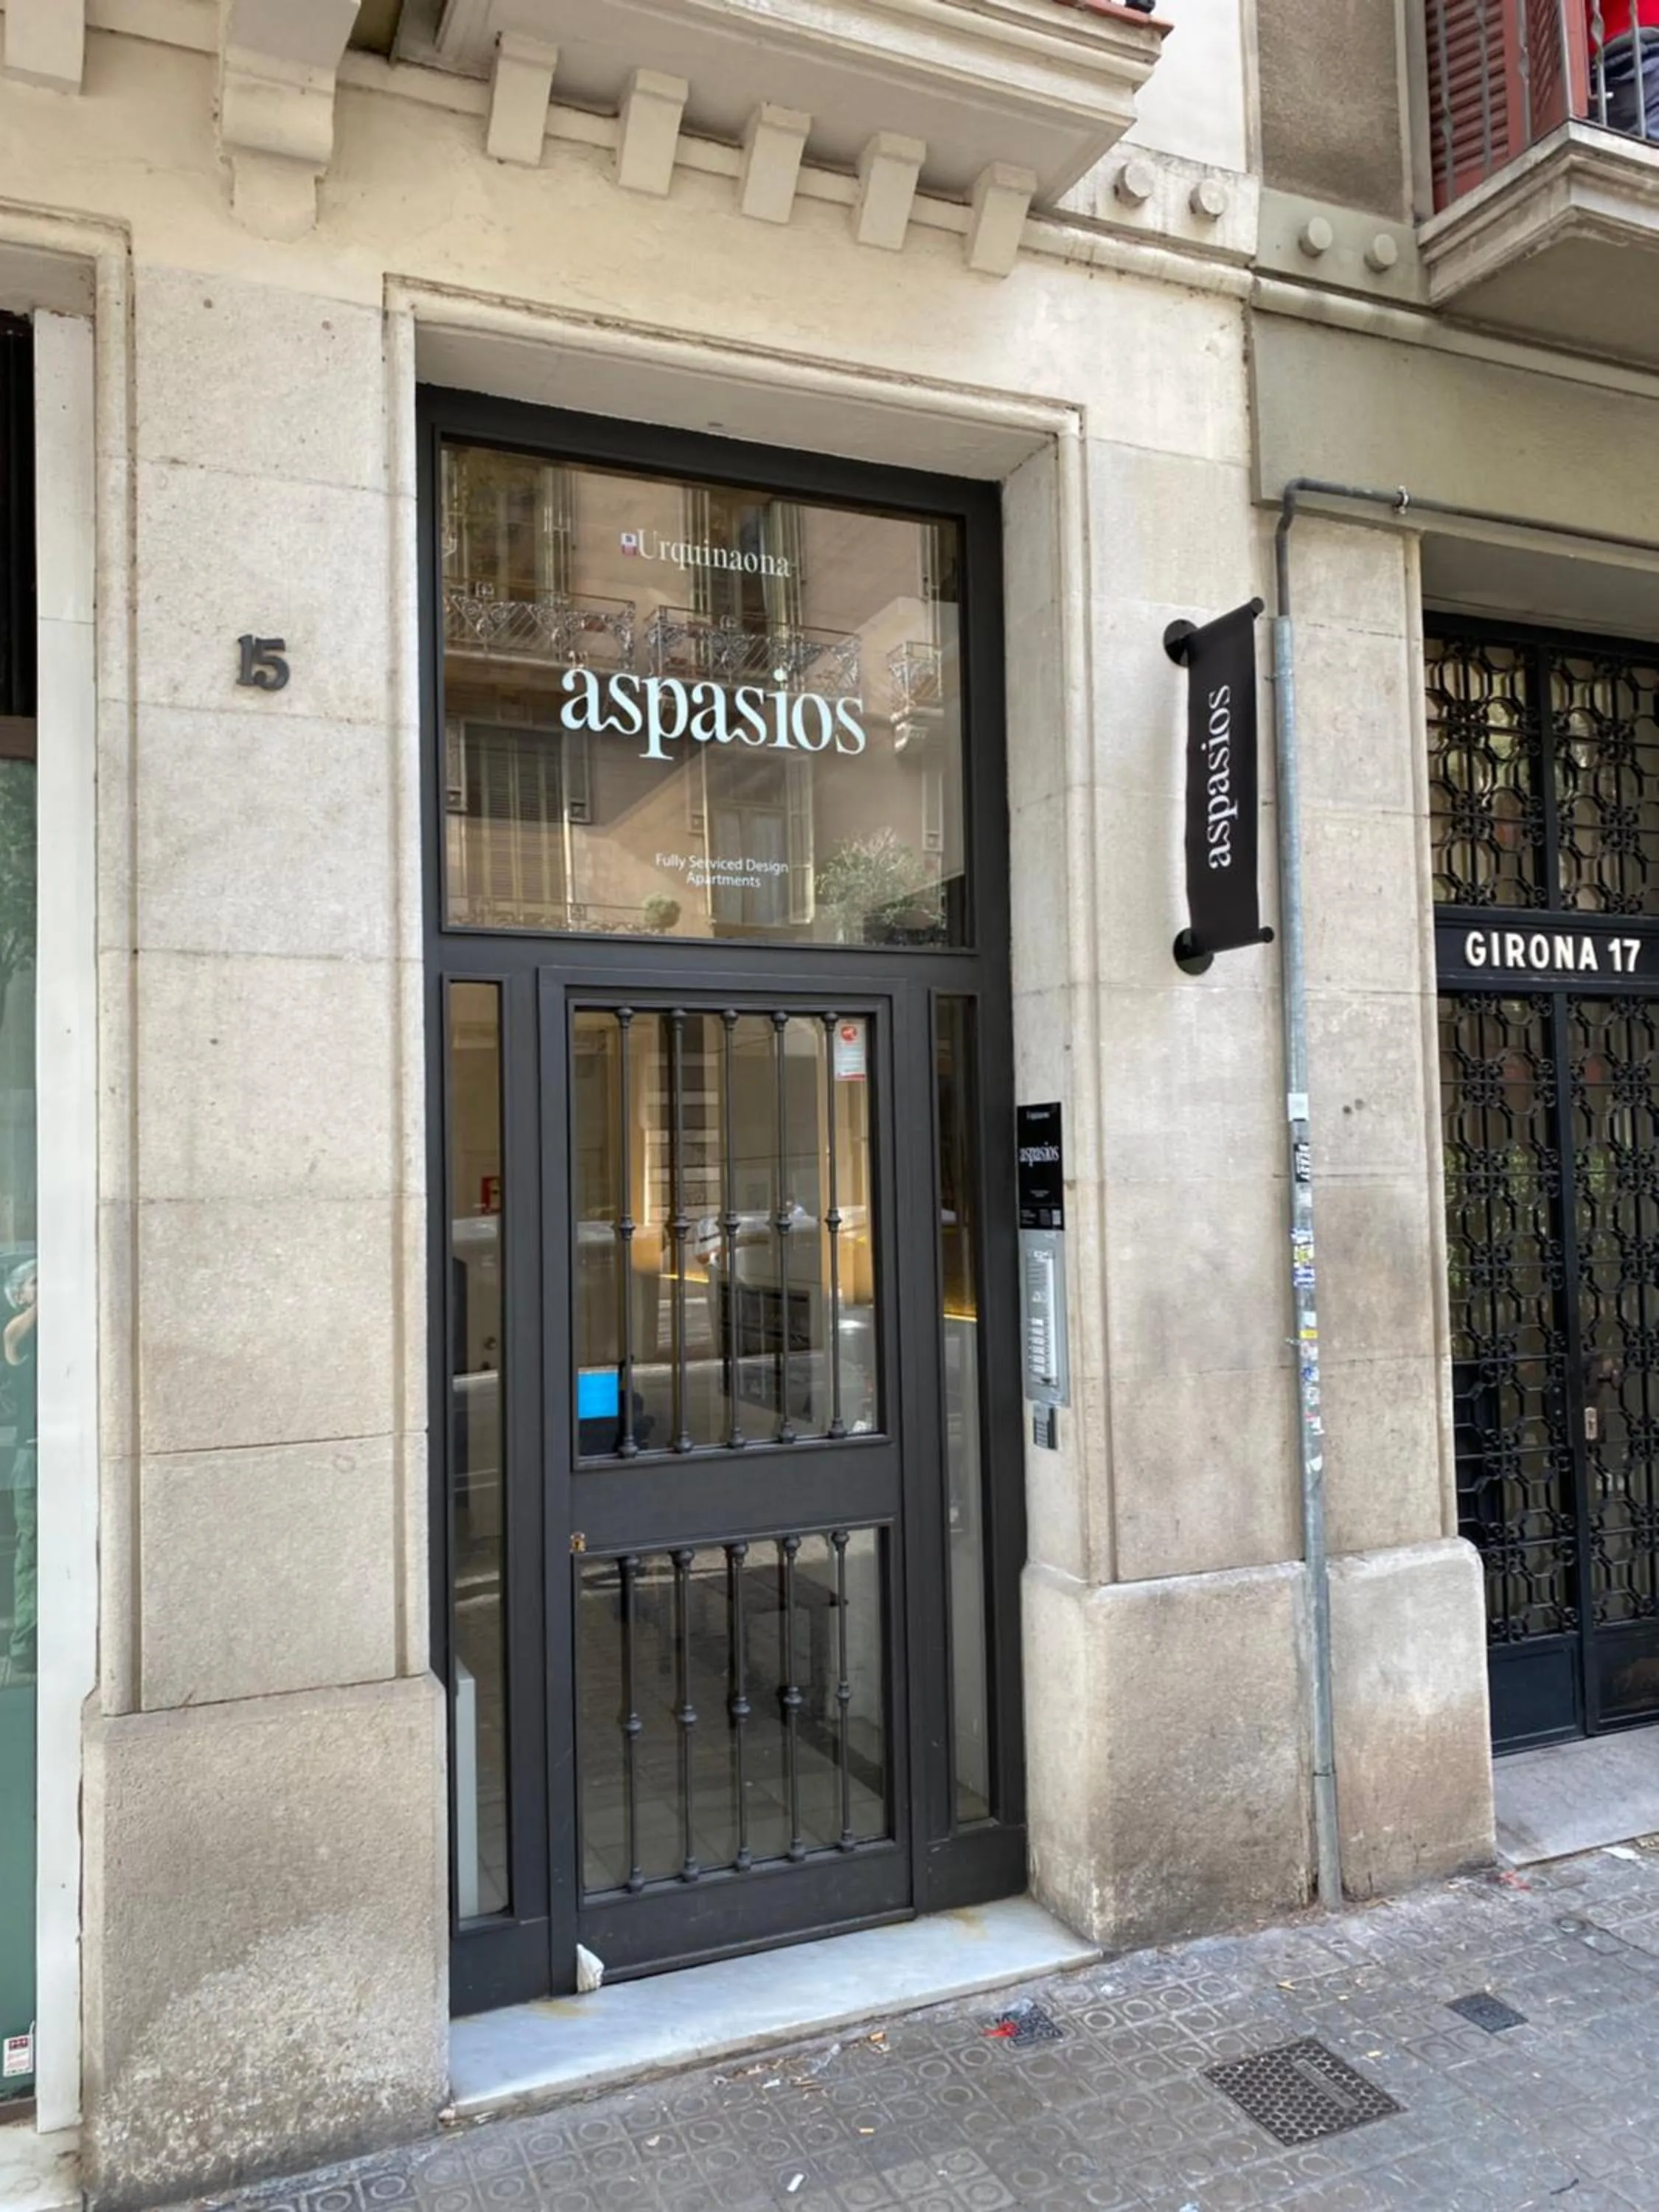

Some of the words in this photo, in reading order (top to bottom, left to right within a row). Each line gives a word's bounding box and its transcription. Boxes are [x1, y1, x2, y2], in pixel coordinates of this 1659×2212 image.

[637, 528, 790, 578] Urquinaona
[236, 633, 290, 692] 15
[560, 667, 867, 760] aspasios
[1200, 684, 1239, 869] aspasios
[655, 853, 686, 871] Fully
[689, 855, 742, 871] Serviced
[745, 858, 789, 875] Design
[686, 871, 762, 888] Apartments
[1465, 931, 1599, 972] GIRONA
[1608, 937, 1641, 973] 17
